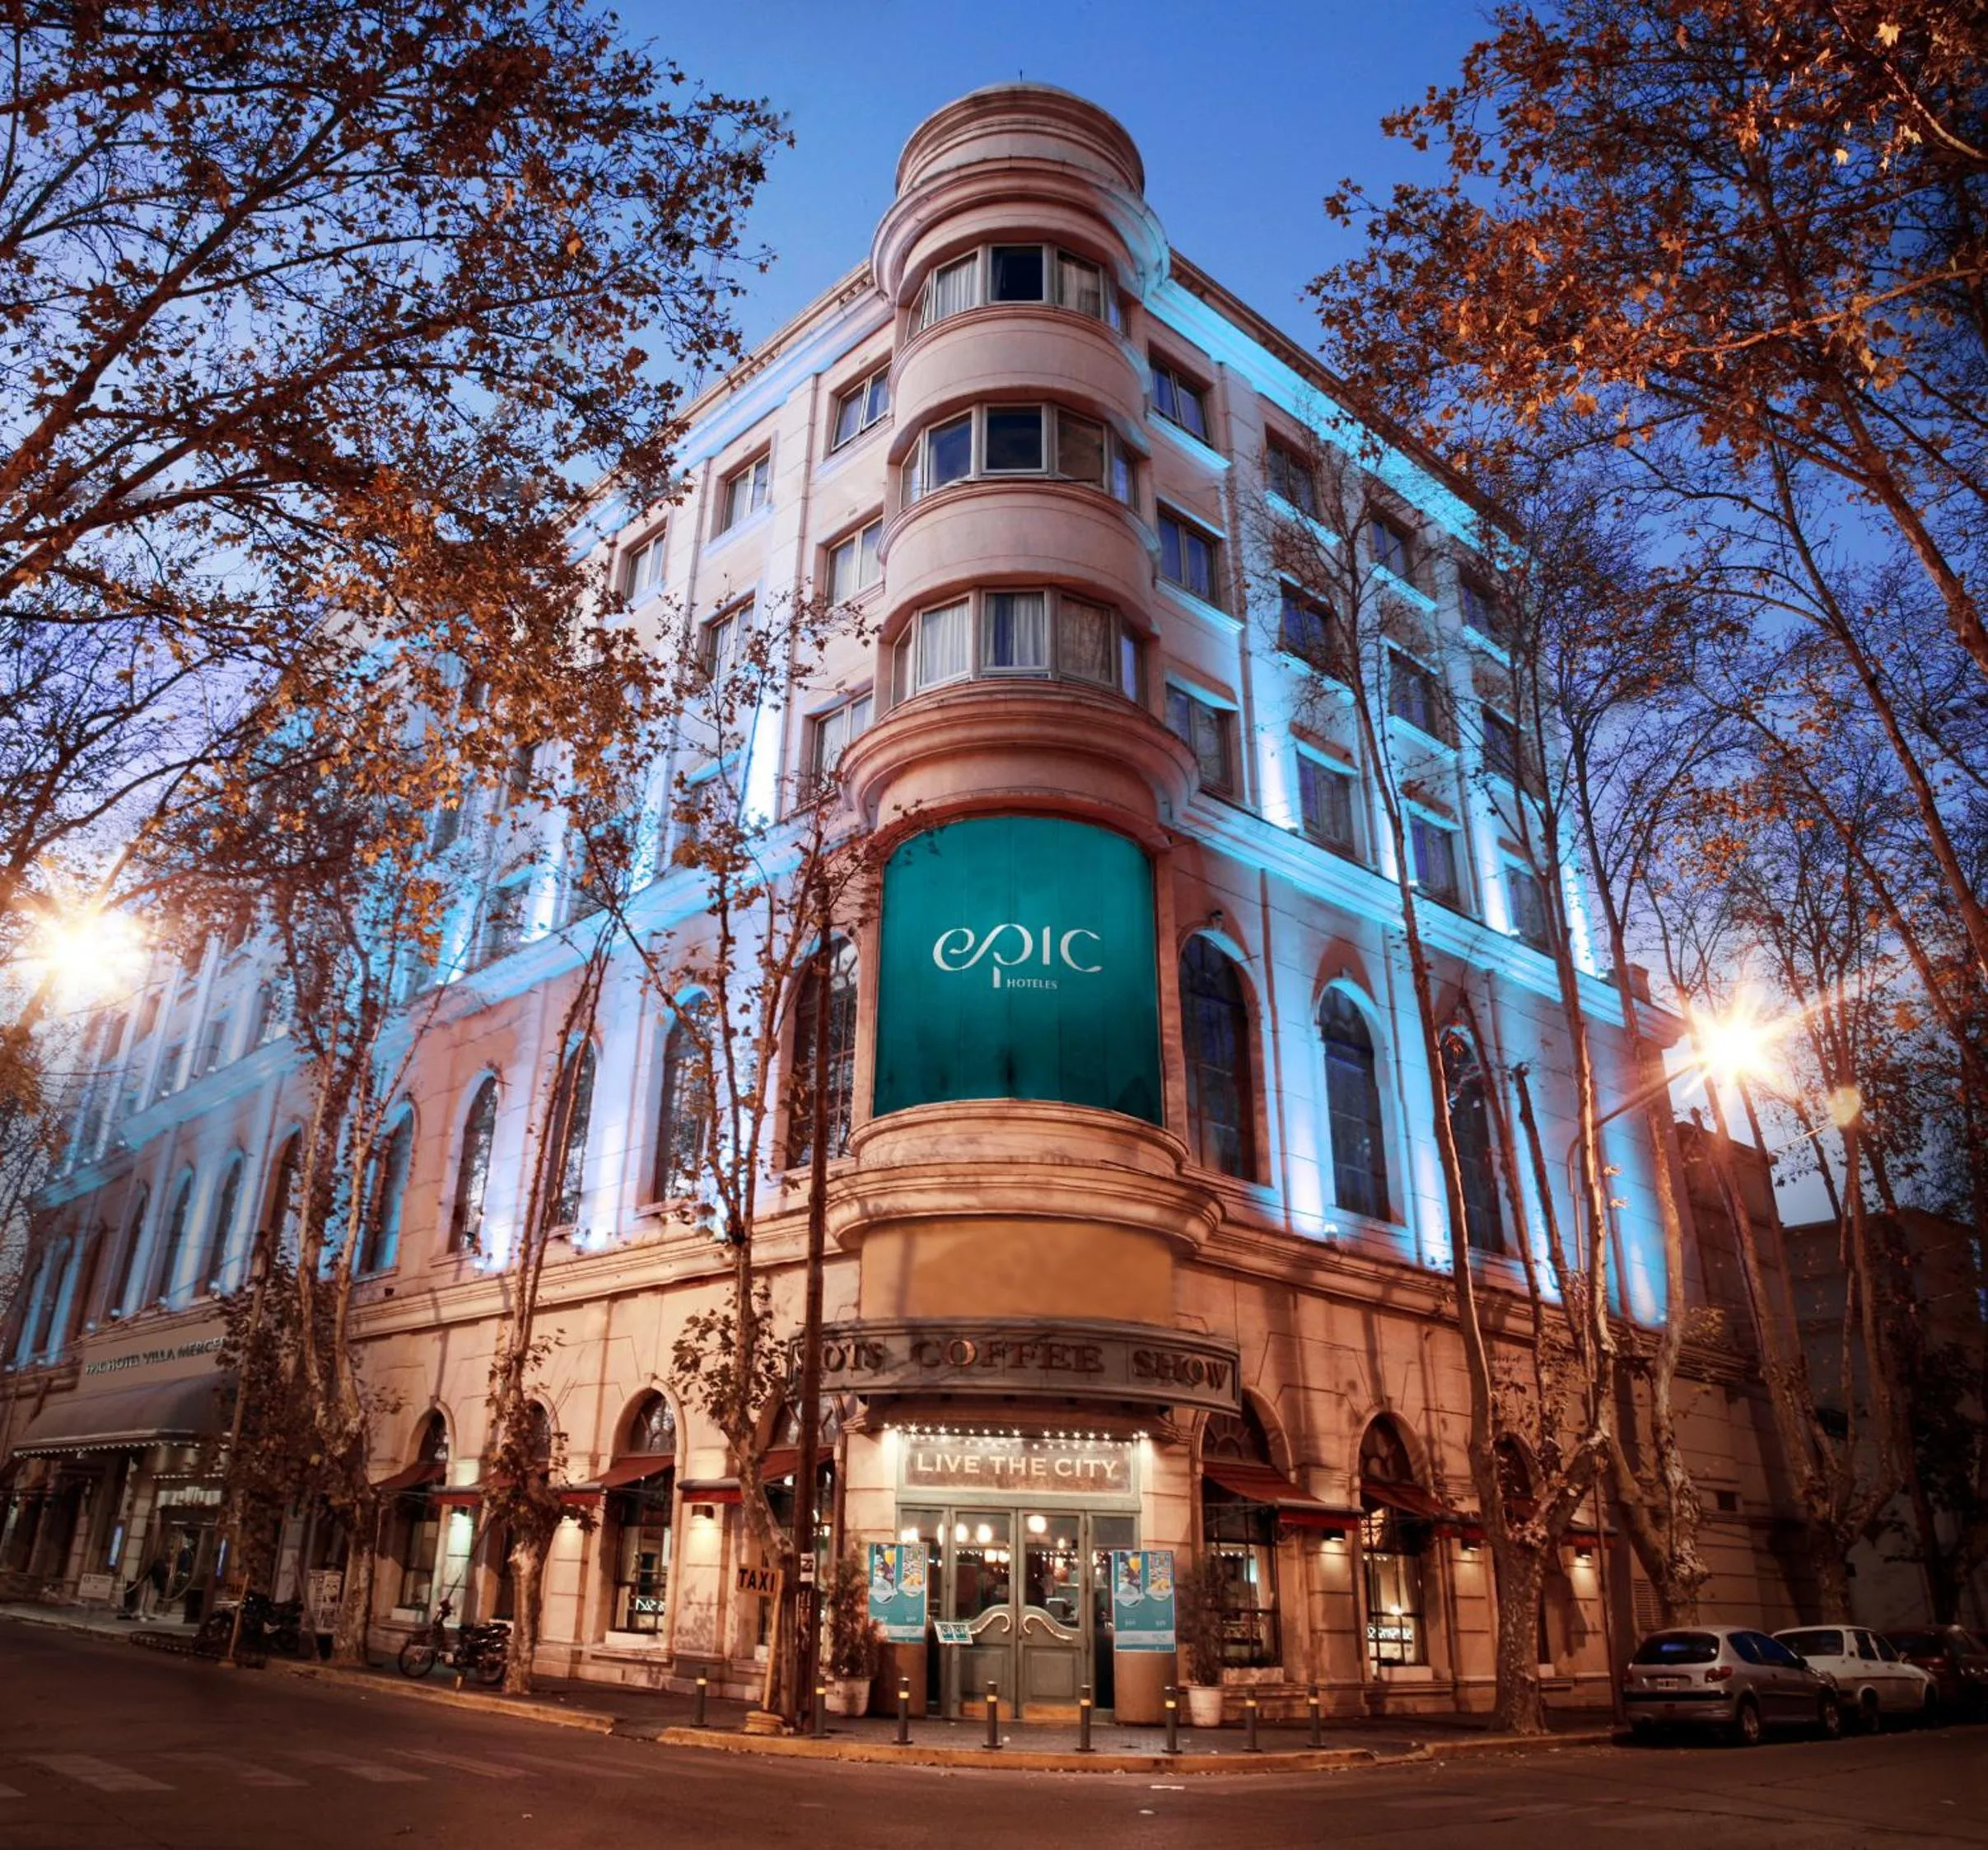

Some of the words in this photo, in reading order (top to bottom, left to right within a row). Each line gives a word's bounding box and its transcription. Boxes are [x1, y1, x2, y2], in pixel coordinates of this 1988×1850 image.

[1006, 978, 1057, 989] HOTELES
[142, 1349, 175, 1364] VILLA
[909, 1337, 1105, 1373] COFFEE
[1132, 1349, 1230, 1391] SHOW
[917, 1452, 982, 1474] LIVE
[989, 1455, 1048, 1476] THE
[1054, 1457, 1118, 1479] CITY
[738, 1568, 776, 1593] TAXI
